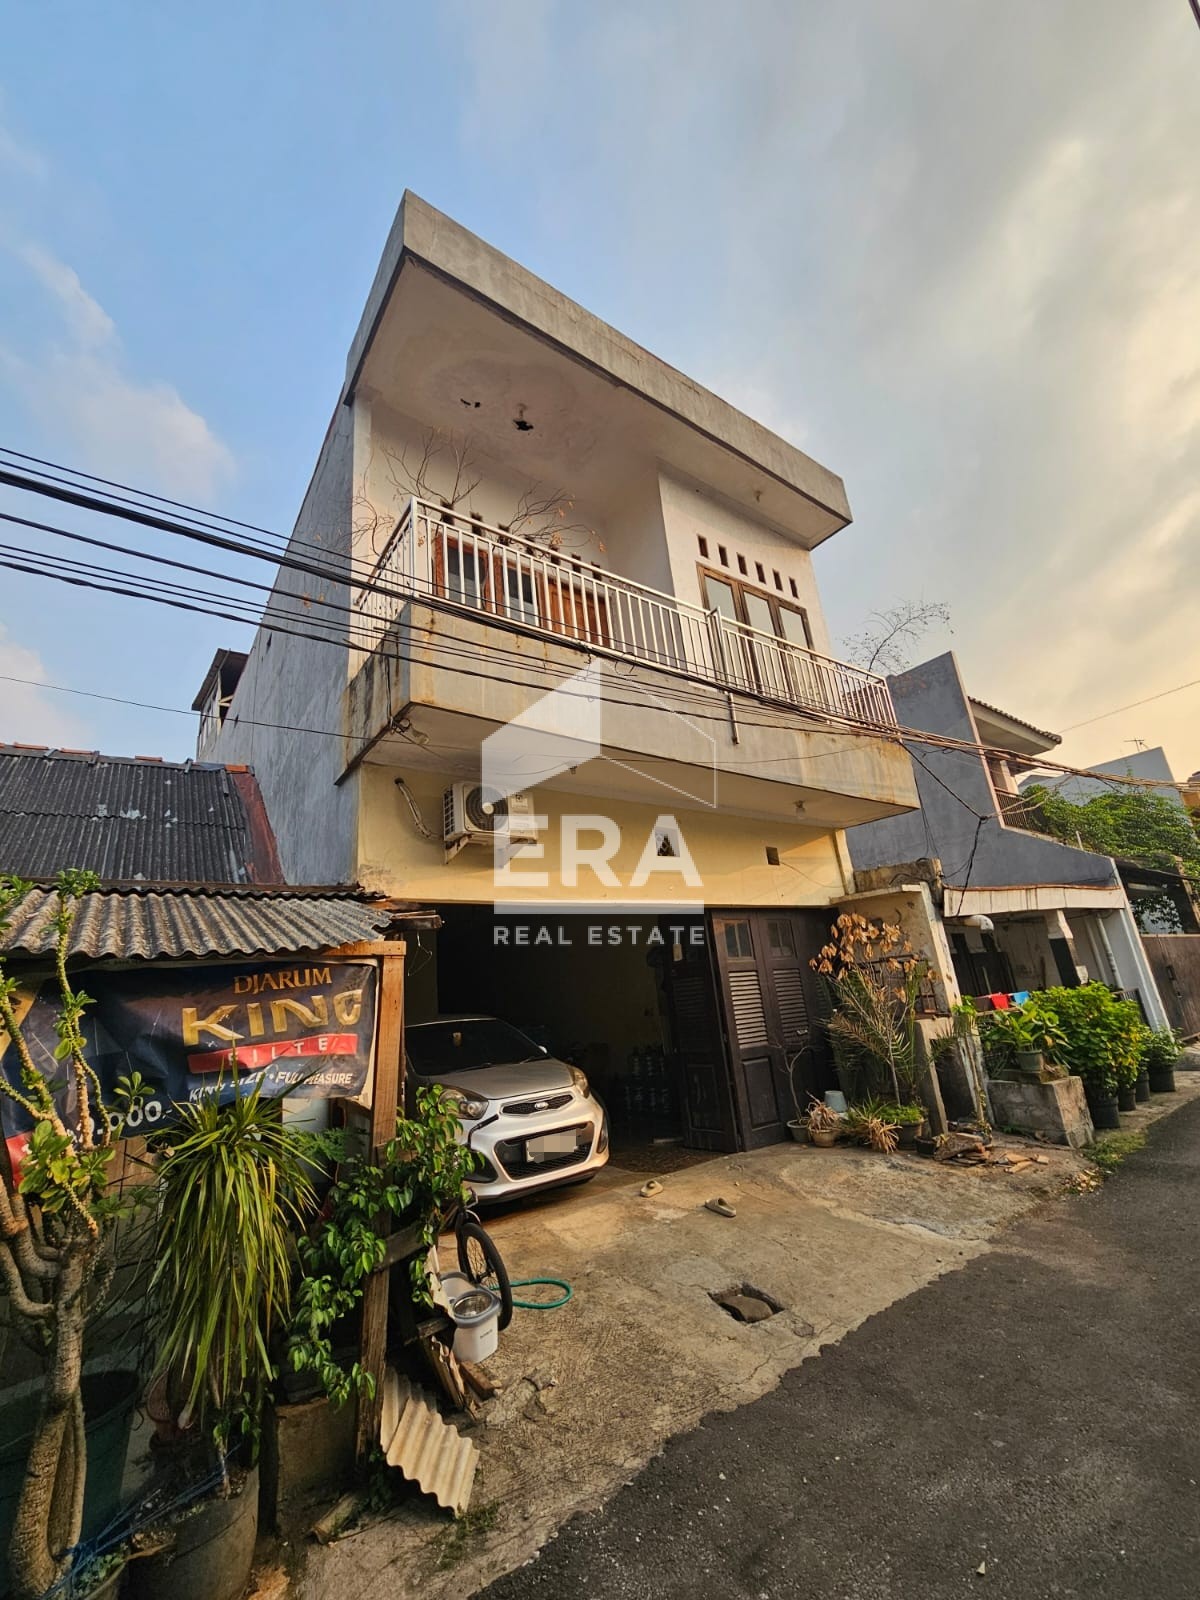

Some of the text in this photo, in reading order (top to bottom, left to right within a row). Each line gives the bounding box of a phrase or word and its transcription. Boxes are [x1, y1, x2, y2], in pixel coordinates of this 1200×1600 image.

[233, 967, 333, 994] DJARUM
[182, 989, 363, 1047] KING
[227, 1037, 339, 1066] FILTE
